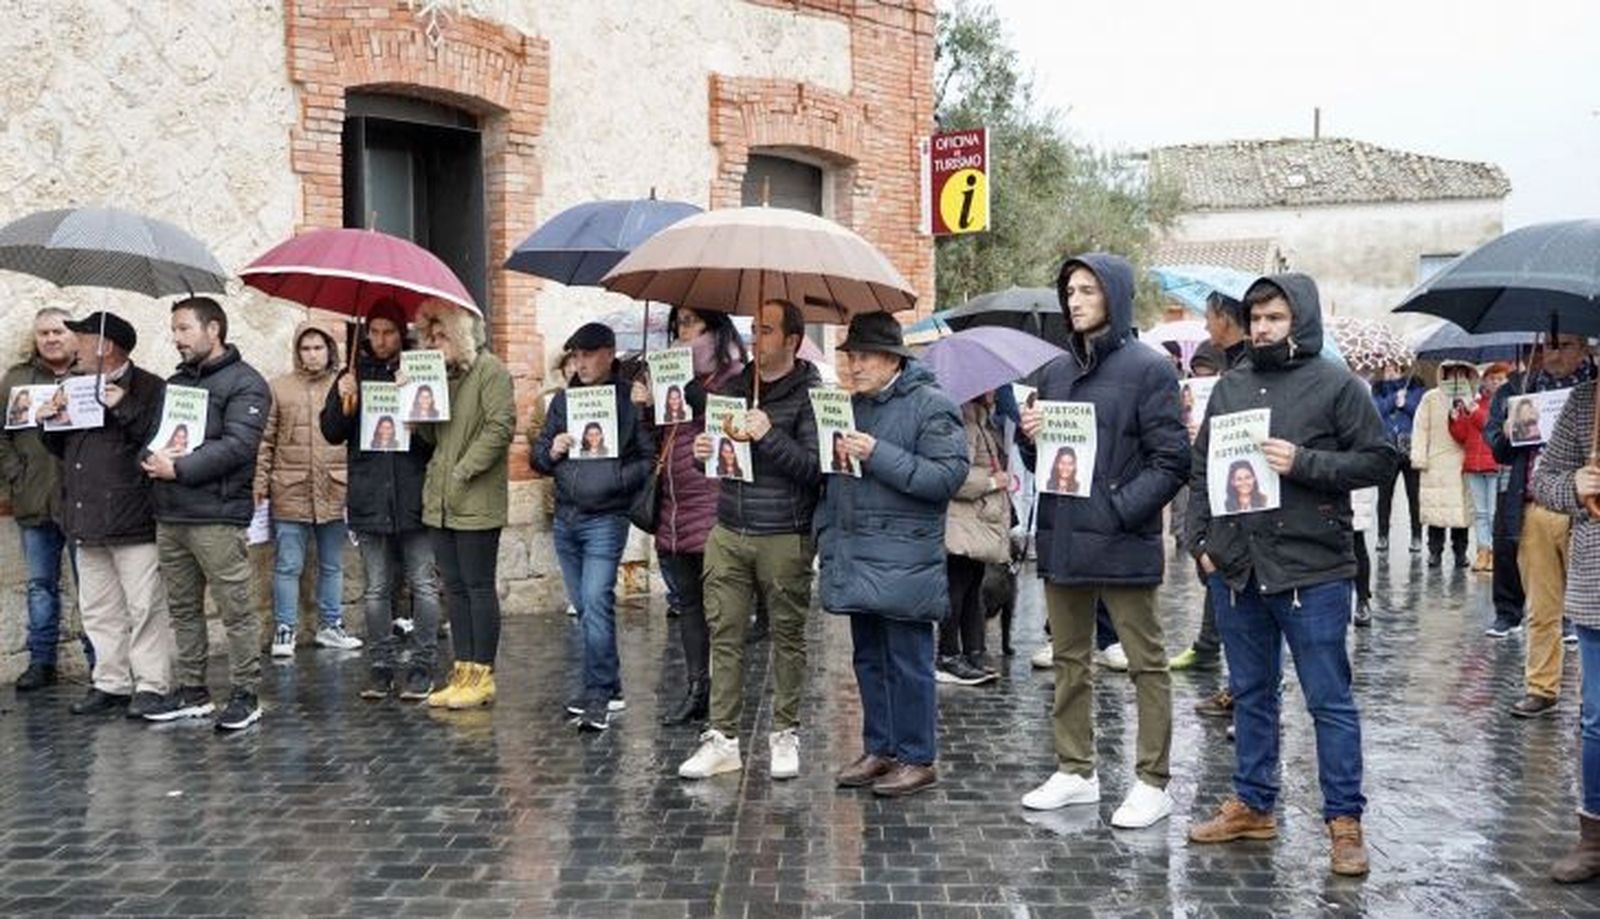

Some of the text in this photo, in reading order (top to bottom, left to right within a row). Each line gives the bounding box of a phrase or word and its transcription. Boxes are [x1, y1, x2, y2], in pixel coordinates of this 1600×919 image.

[934, 153, 982, 172] TURISMO
[1047, 419, 1078, 429] PARA
[1042, 433, 1087, 443] ESTHER
